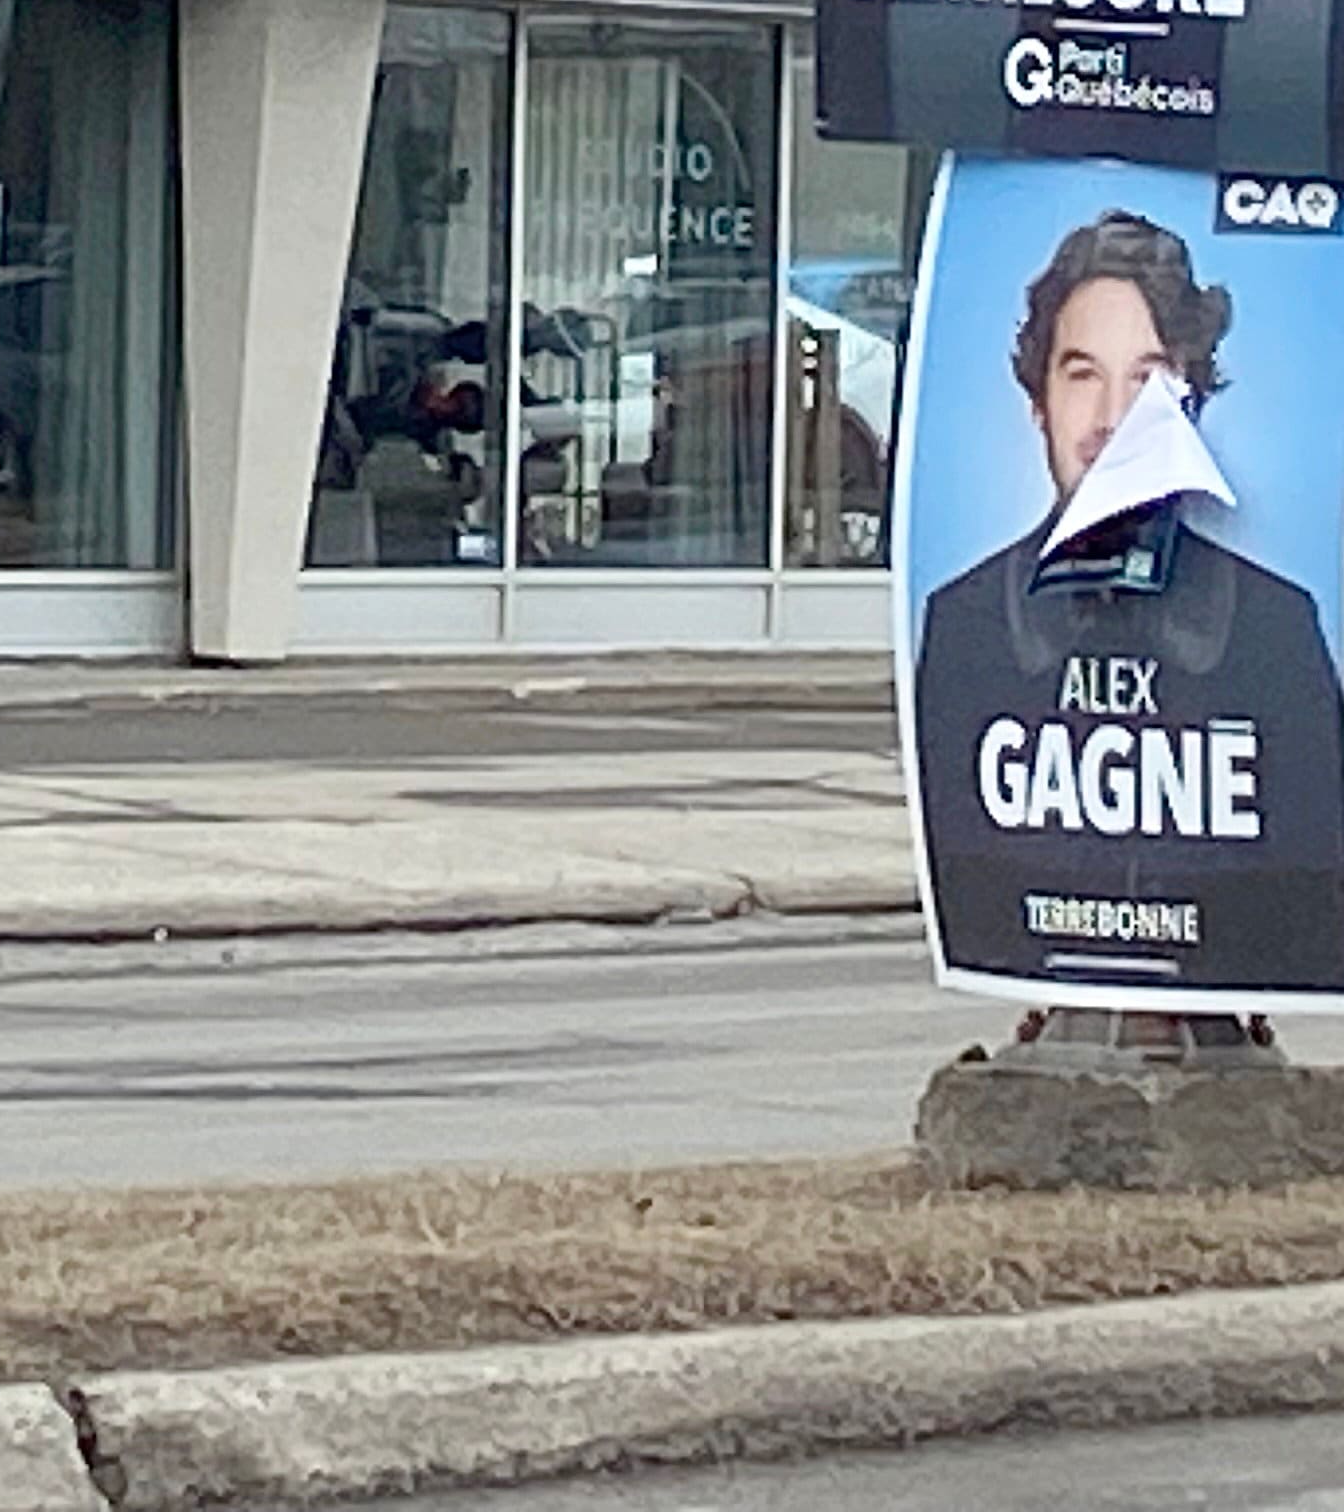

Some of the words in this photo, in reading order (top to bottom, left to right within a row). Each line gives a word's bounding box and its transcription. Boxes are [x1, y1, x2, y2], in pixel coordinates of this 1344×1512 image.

[1223, 179, 1339, 227] CAQ
[1060, 656, 1159, 714] ALEX
[1025, 895, 1200, 942] TERREBONNE
